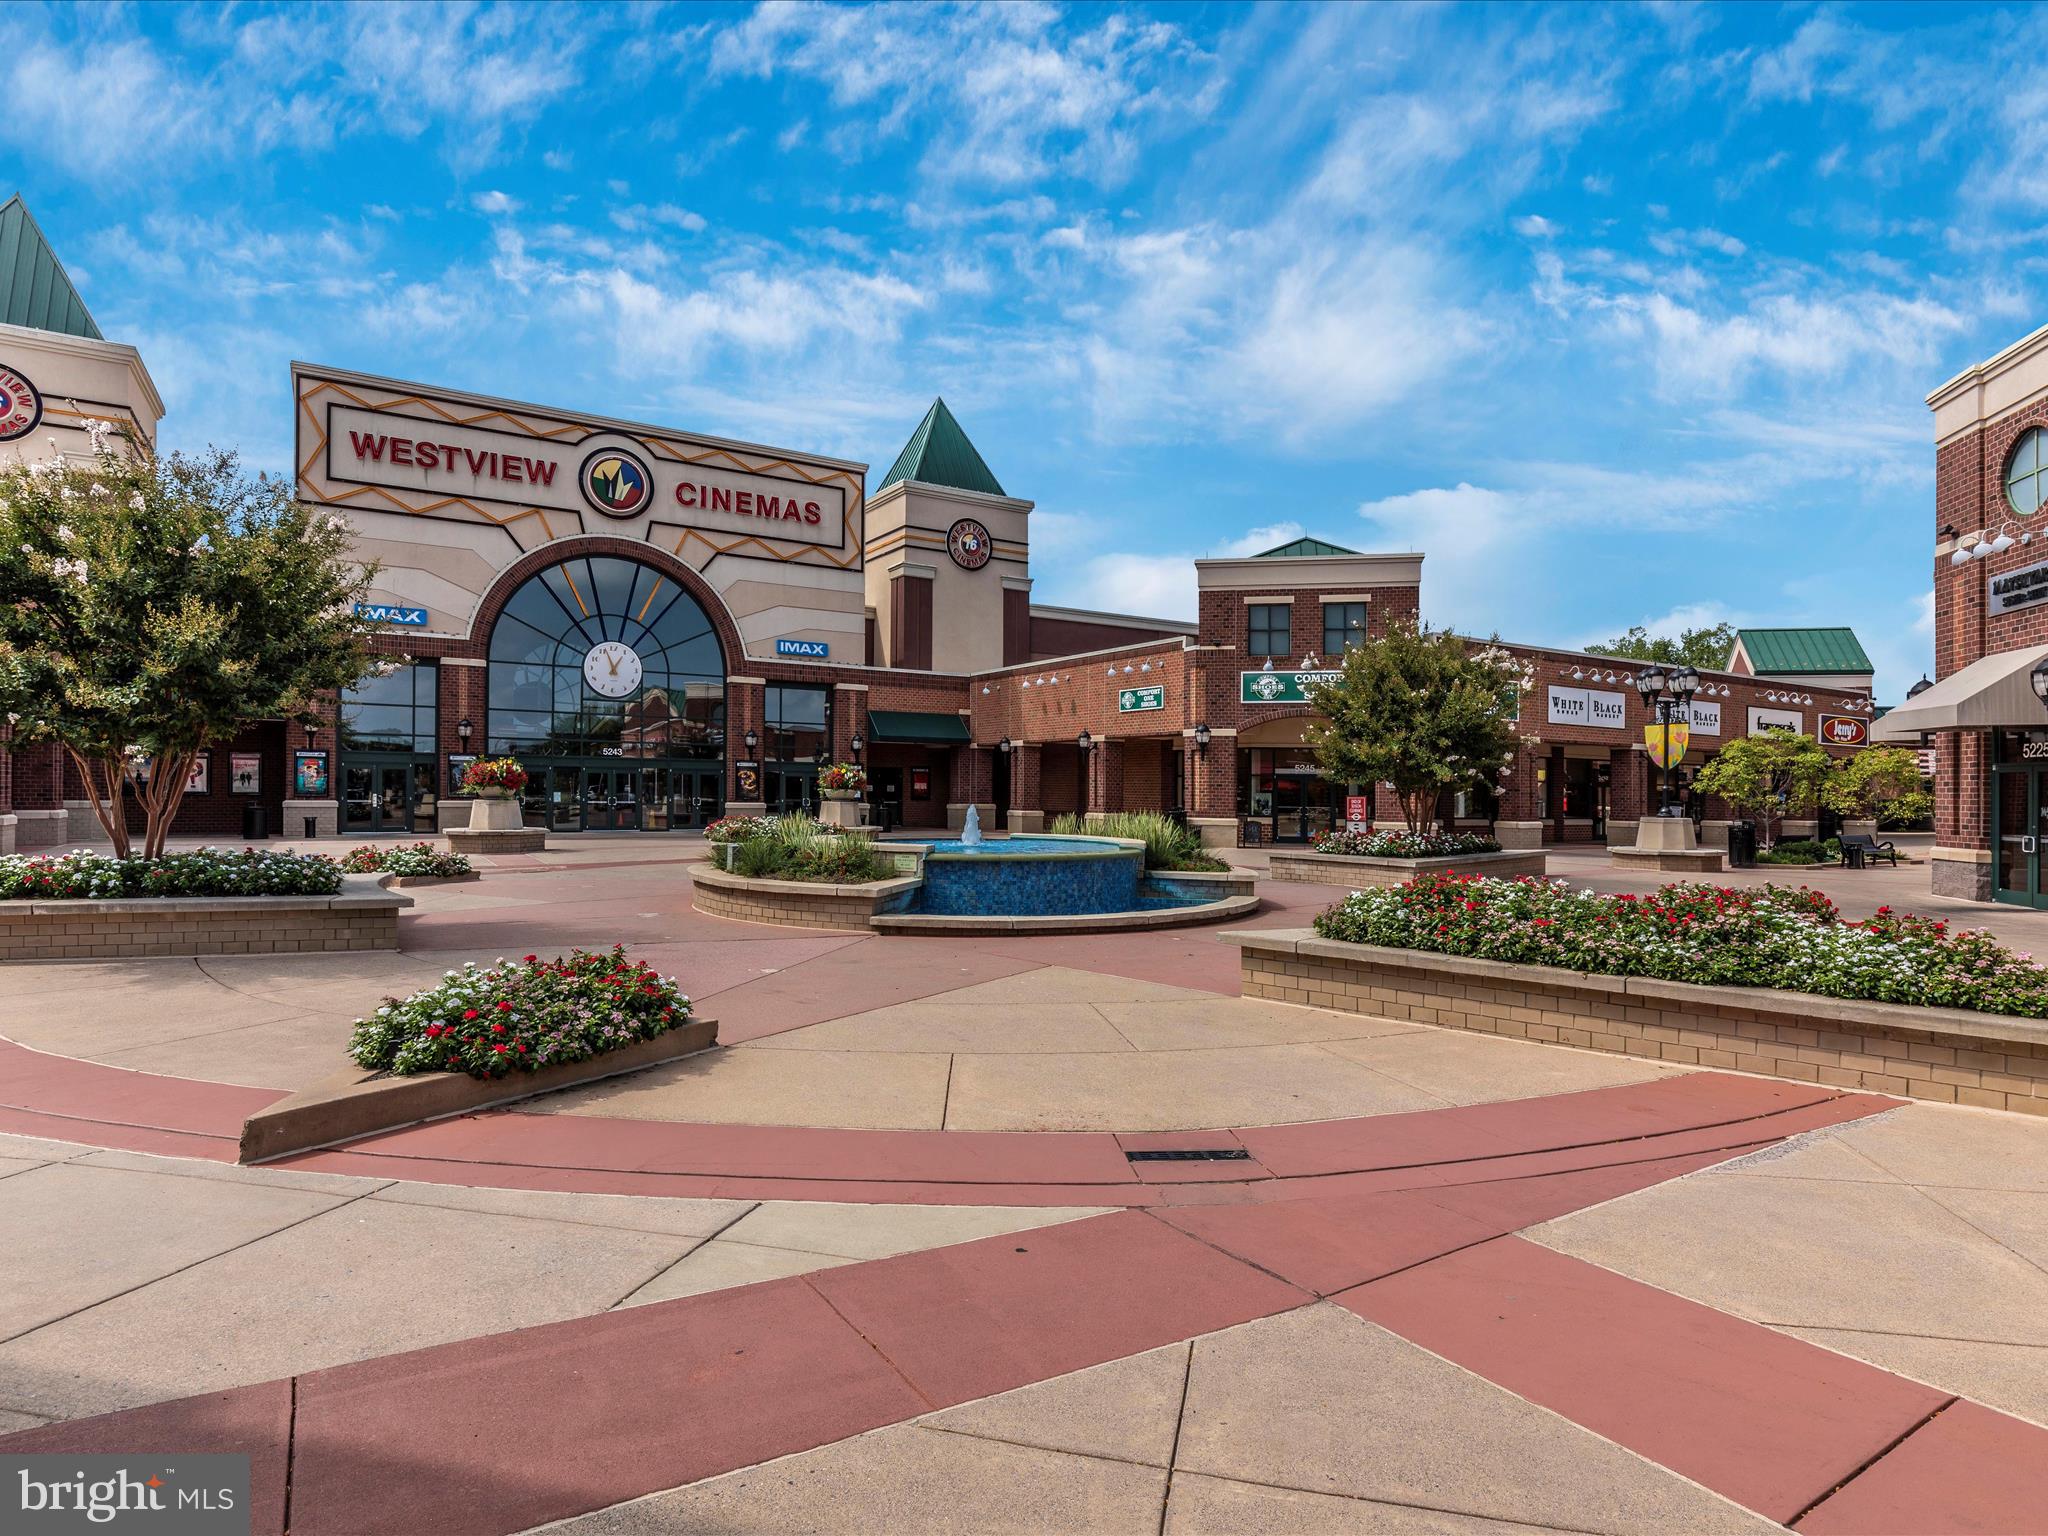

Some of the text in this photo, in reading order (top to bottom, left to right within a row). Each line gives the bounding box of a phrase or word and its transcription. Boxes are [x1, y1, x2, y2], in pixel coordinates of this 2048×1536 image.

[349, 431, 821, 525] WESTVIEW CINEMAS
[951, 523, 988, 547] WESTVIEW
[953, 548, 987, 566] CINEMAS
[780, 642, 824, 654] IMAX
[1295, 674, 1345, 683] COMFOR
[1552, 696, 1623, 715] WHITE BLACK
[1693, 710, 1719, 723] BLACK
[602, 748, 623, 756] 5243
[2023, 742, 2048, 758] 5225
